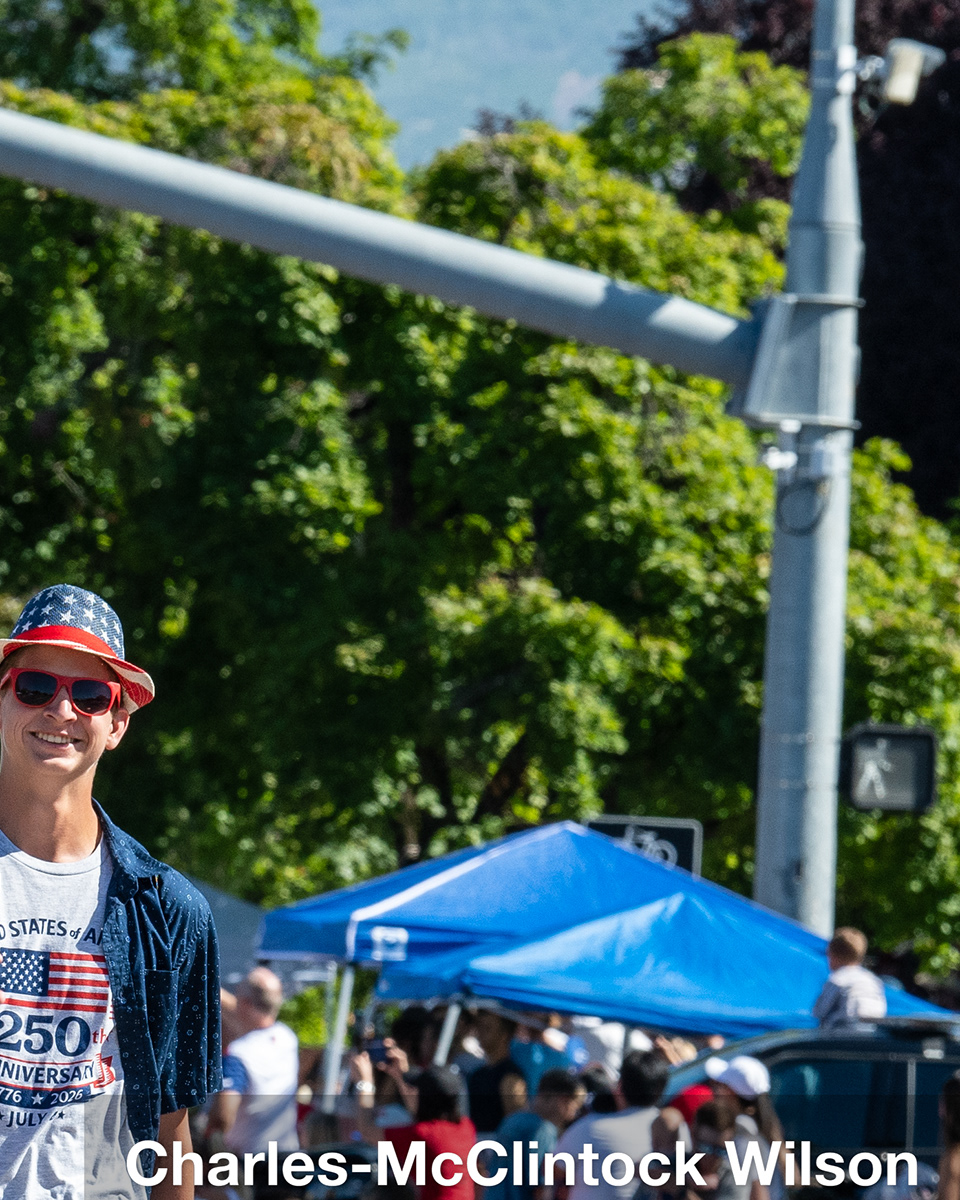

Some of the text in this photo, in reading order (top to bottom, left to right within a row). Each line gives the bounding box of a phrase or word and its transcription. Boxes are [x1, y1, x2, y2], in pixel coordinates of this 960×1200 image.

[8, 918, 67, 938] STATES
[69, 927, 82, 940] of
[50, 1089, 83, 1105] 2026
[6, 1110, 48, 1127] JULY
